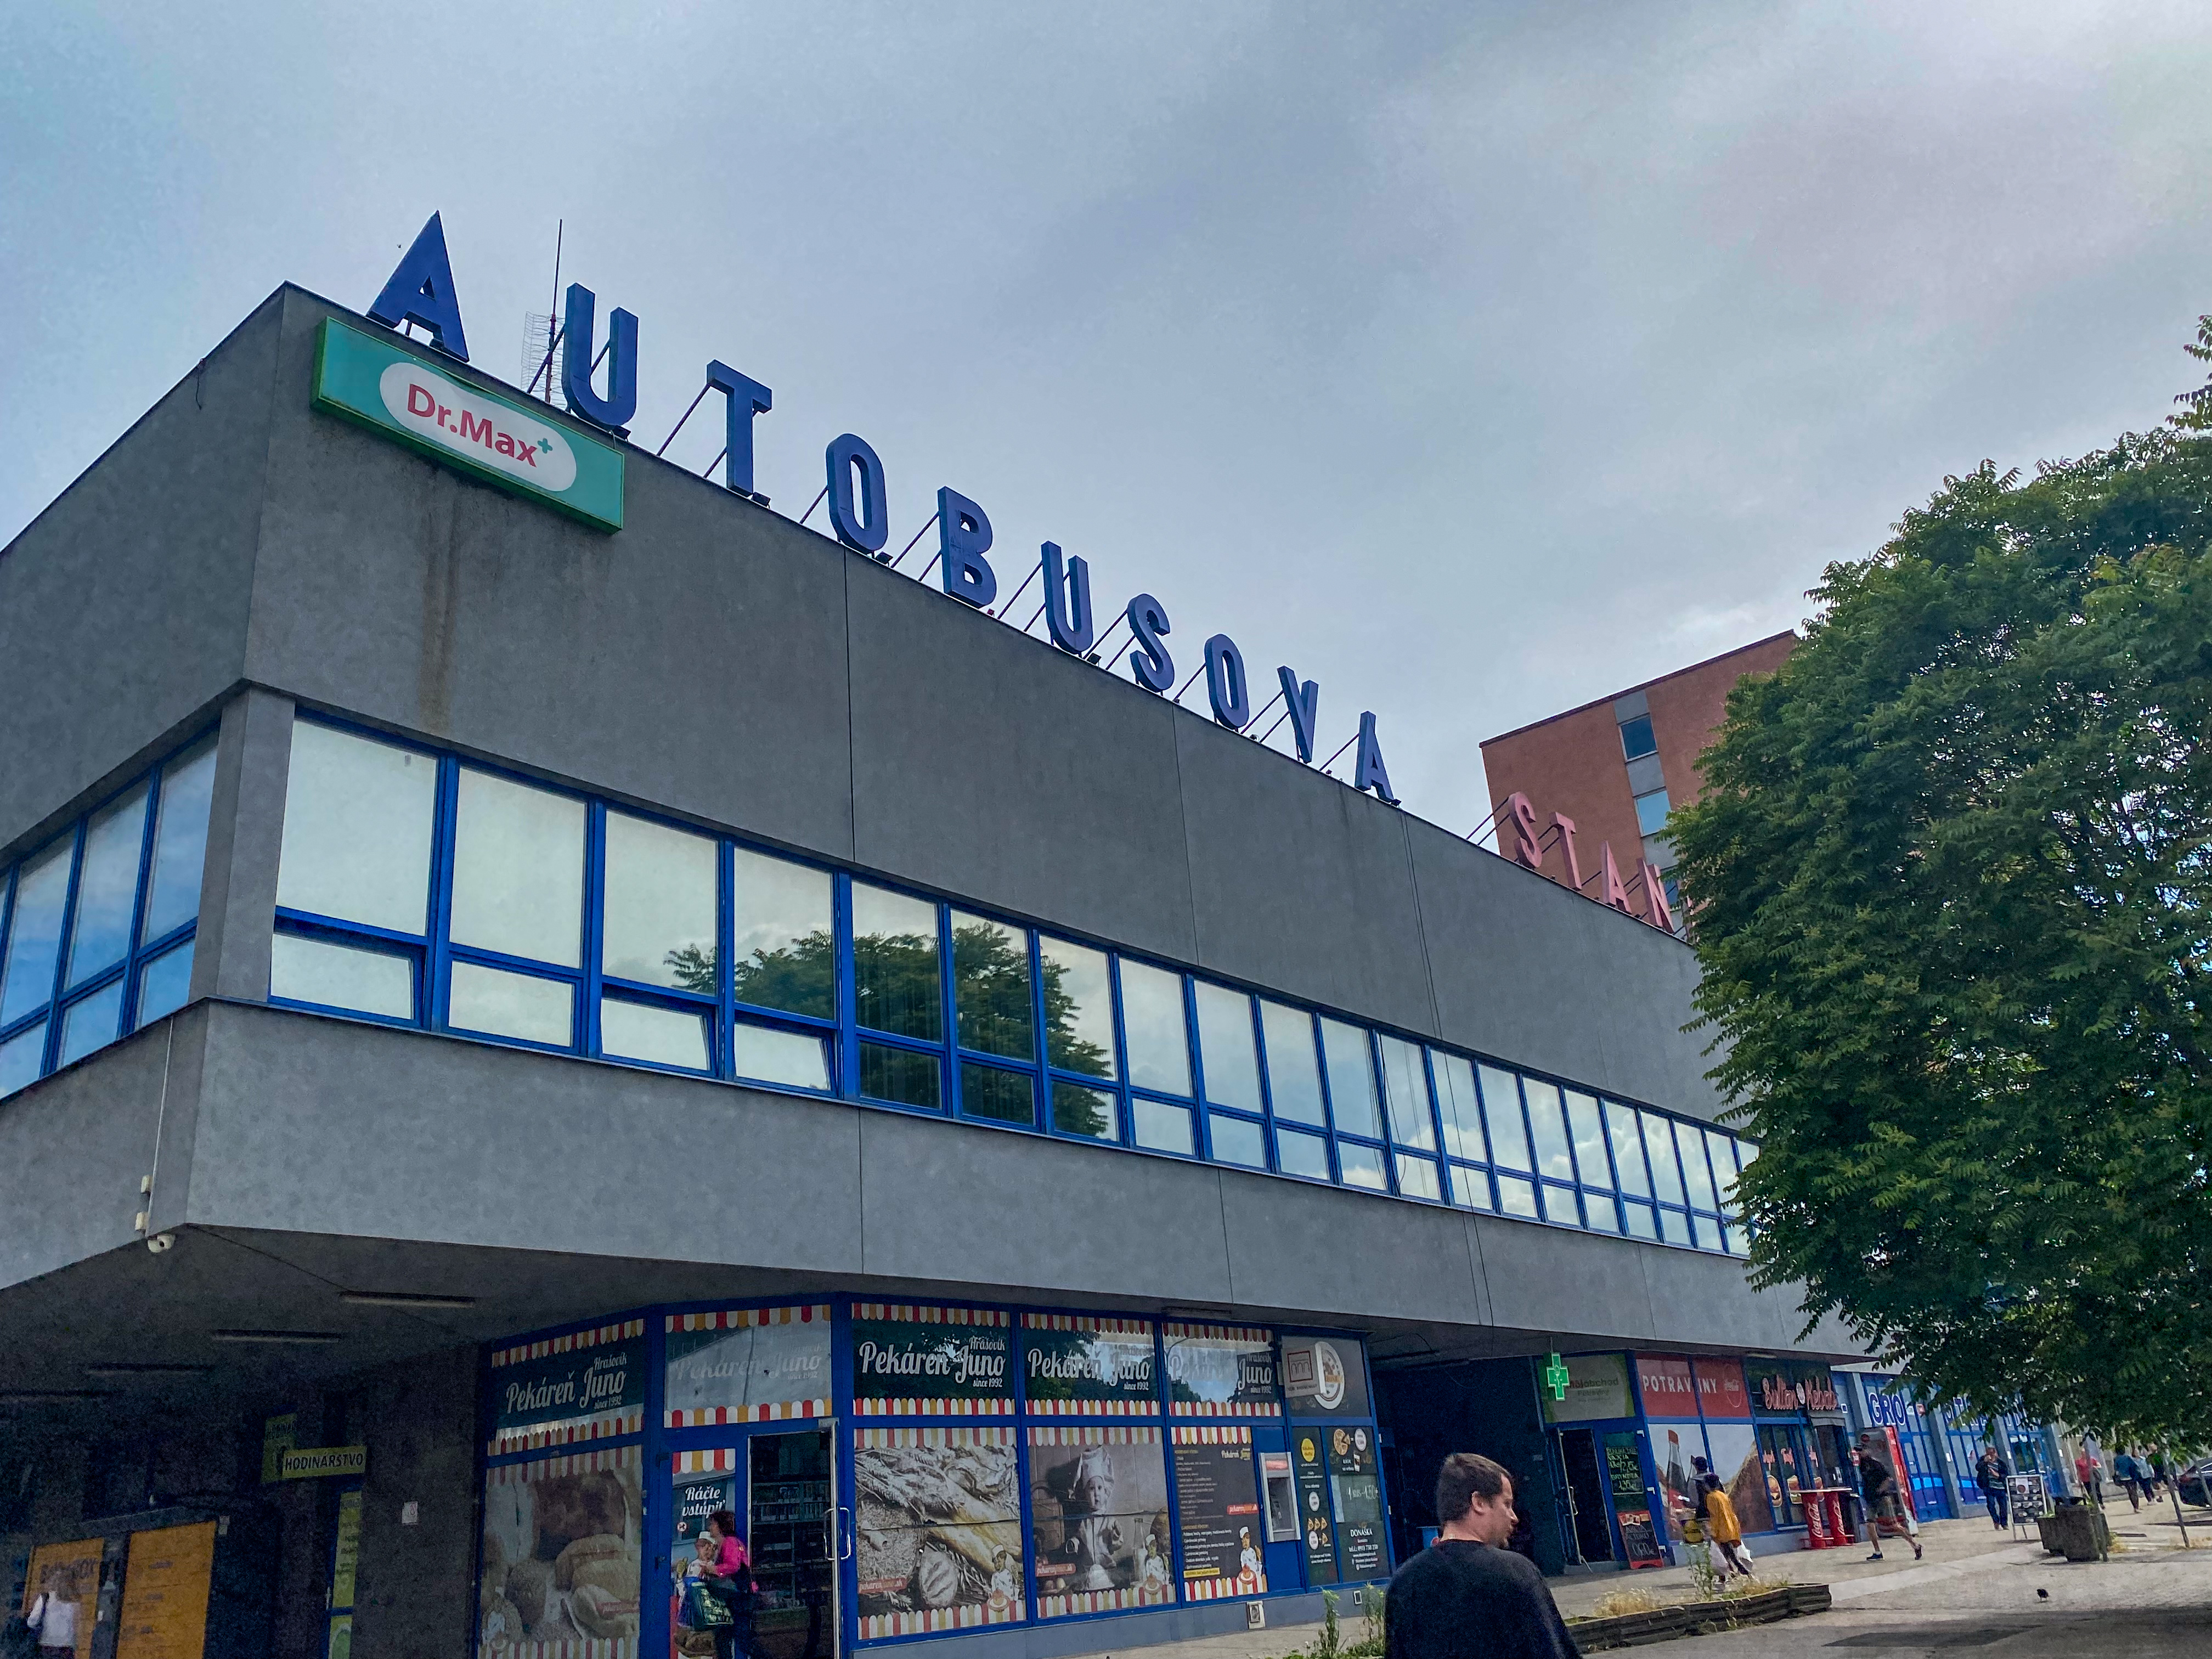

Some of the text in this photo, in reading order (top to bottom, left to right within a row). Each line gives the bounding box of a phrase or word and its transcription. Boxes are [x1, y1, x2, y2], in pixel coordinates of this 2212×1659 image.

[1508, 791, 1695, 943] STAN
[955, 1345, 1006, 1384] Juno
[1109, 1351, 1151, 1387] Juno
[1238, 1358, 1272, 1390] Juno
[506, 1367, 627, 1414] Pekáreň Juno
[973, 1378, 1003, 1388] since 1992
[1123, 1381, 1149, 1391] since 1992
[1642, 1375, 1717, 1394] POTRAVINY
[1762, 1374, 1837, 1411] Sultan Kebab
[594, 1395, 622, 1410] since 1992
[285, 1452, 364, 1471] HODINÁRSTVO
[685, 1485, 721, 1501] Ráčte
